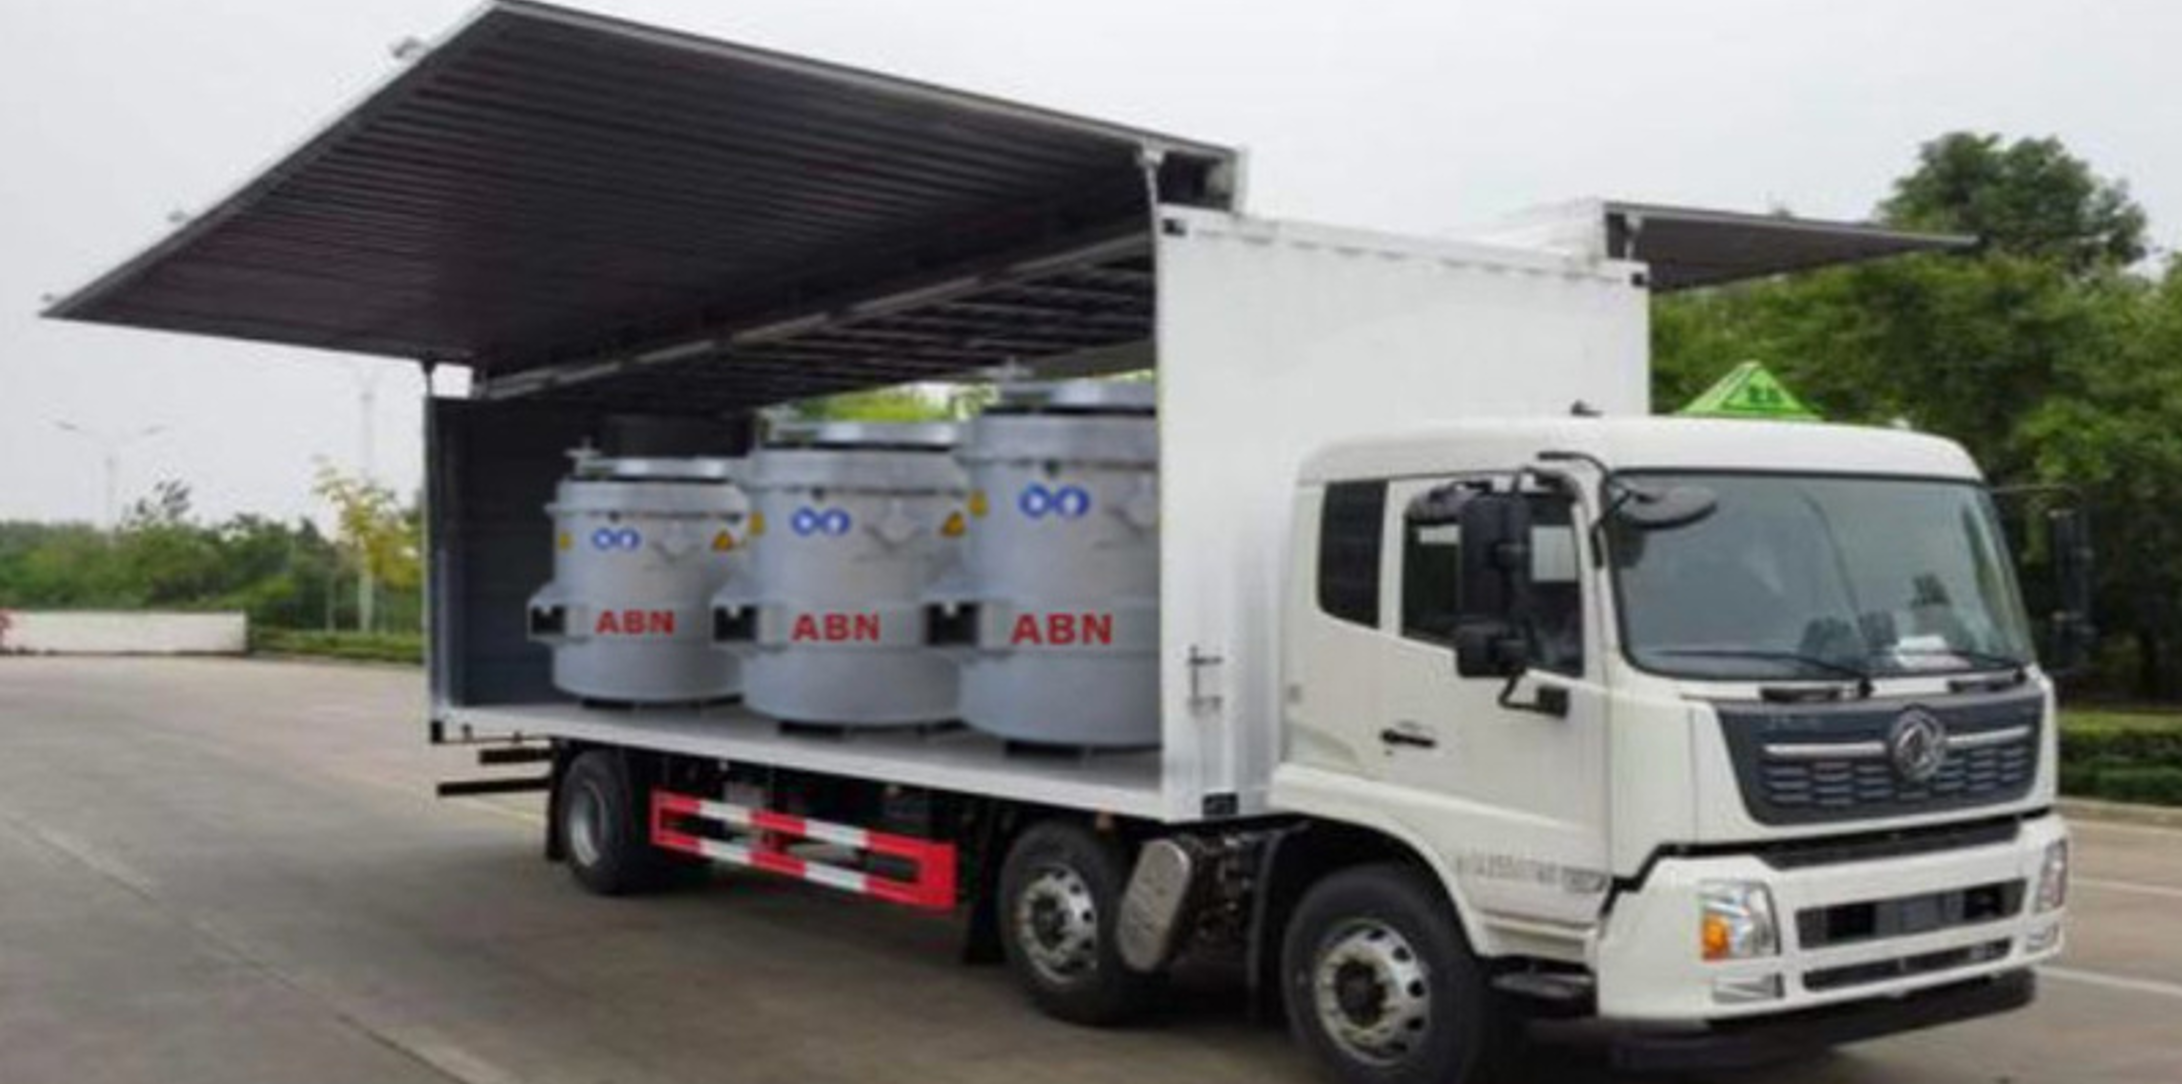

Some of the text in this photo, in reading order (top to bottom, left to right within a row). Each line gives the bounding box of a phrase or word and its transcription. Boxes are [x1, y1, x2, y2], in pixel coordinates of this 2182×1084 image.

[596, 610, 676, 635] ABN
[792, 612, 880, 642] ABN
[1011, 612, 1113, 645] ABN
